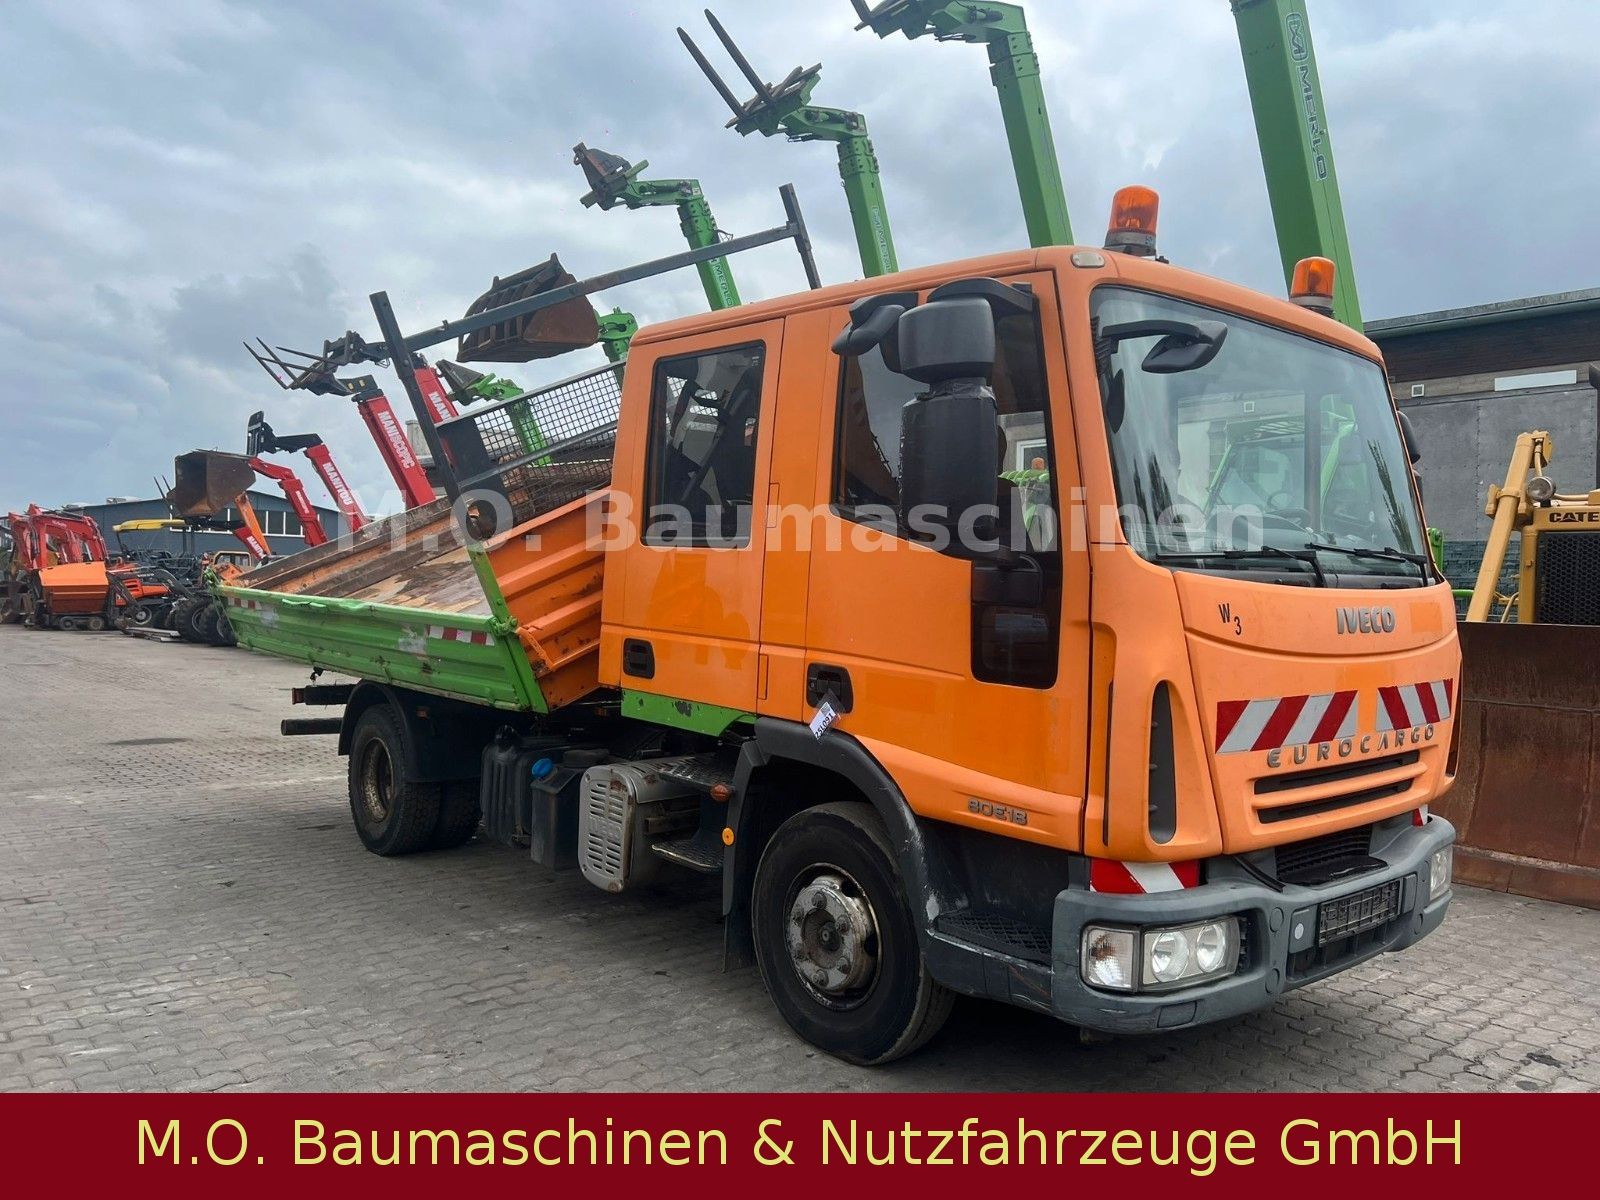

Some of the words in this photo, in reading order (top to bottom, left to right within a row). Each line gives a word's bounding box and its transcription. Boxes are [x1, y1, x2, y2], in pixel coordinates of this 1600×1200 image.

[1299, 65, 1327, 181] MERLO
[378, 410, 416, 469] MANISCOPIC
[322, 462, 353, 506] MANITOU
[1336, 607, 1396, 634] IVECO
[1266, 723, 1435, 768] EUROCARGO
